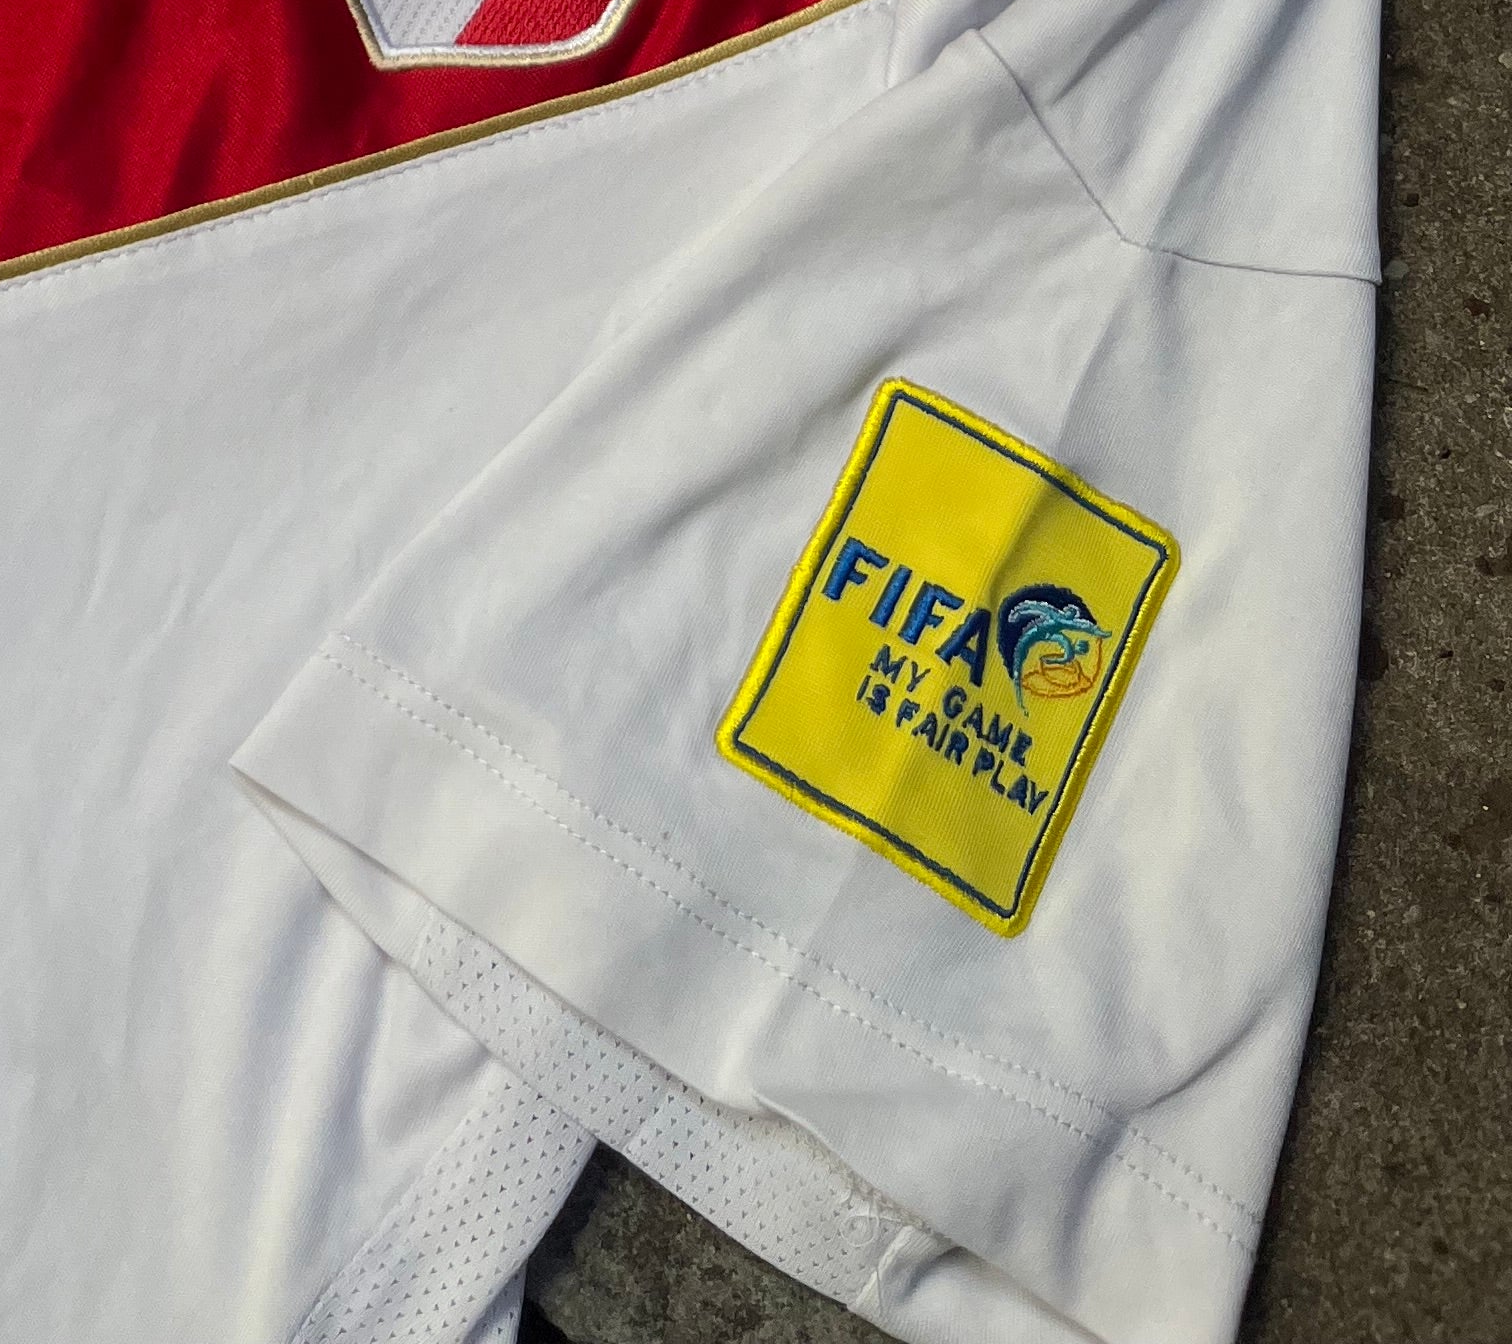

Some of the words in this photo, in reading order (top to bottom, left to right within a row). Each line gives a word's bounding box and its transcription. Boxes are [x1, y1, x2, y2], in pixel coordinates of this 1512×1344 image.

[821, 537, 992, 687] FIFA
[856, 675, 890, 716] IS
[896, 698, 969, 766] FAIR
[972, 746, 1049, 815] PLAY
[870, 644, 931, 692] MY
[943, 685, 1032, 767] GAME
